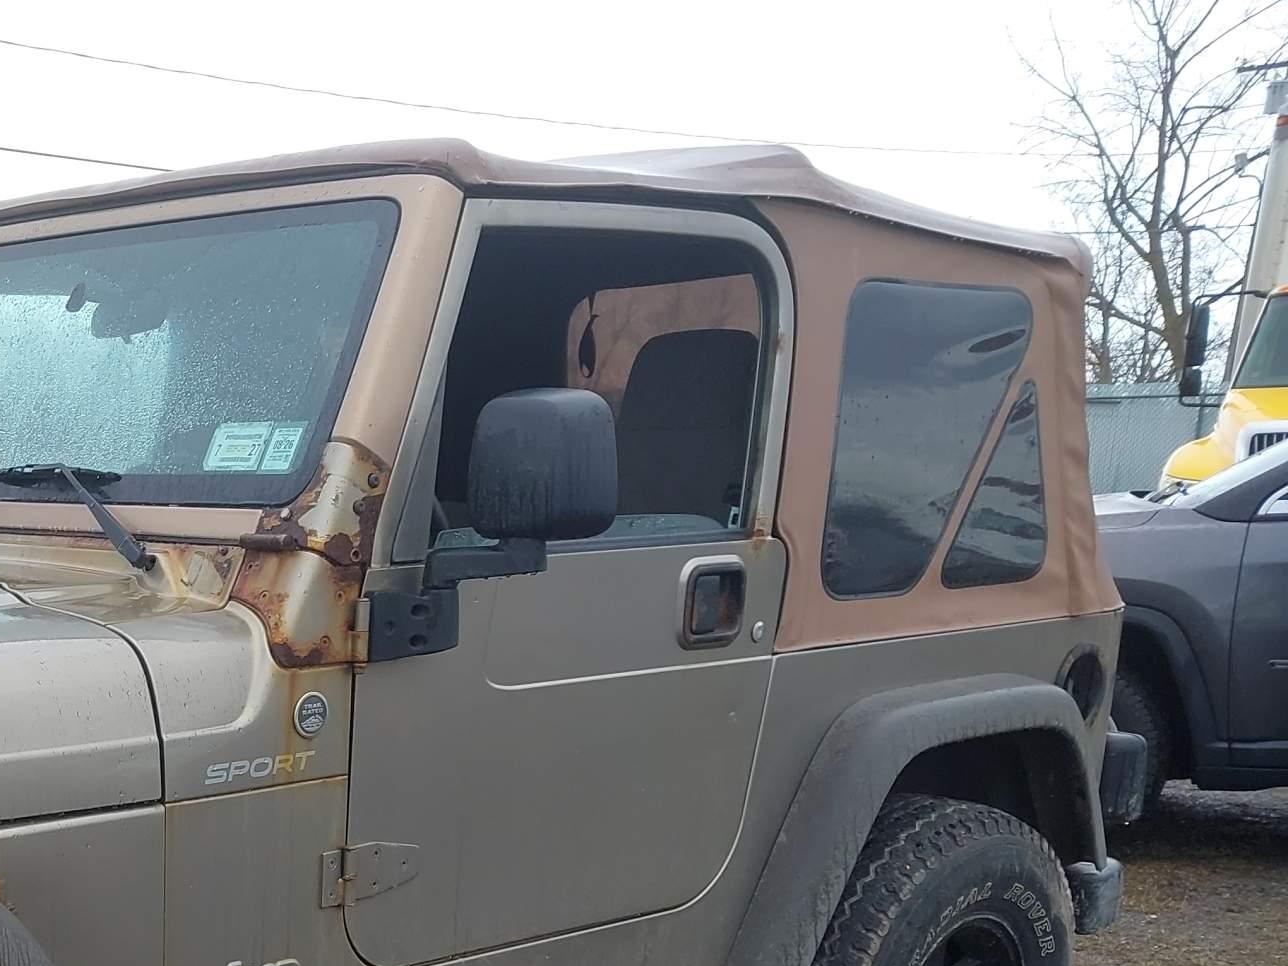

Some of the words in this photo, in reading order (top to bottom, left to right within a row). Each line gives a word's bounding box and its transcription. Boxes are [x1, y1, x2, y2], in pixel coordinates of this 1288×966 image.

[247, 443, 262, 456] 27
[205, 751, 315, 785] SPORT
[1003, 882, 1056, 957] ROVER
